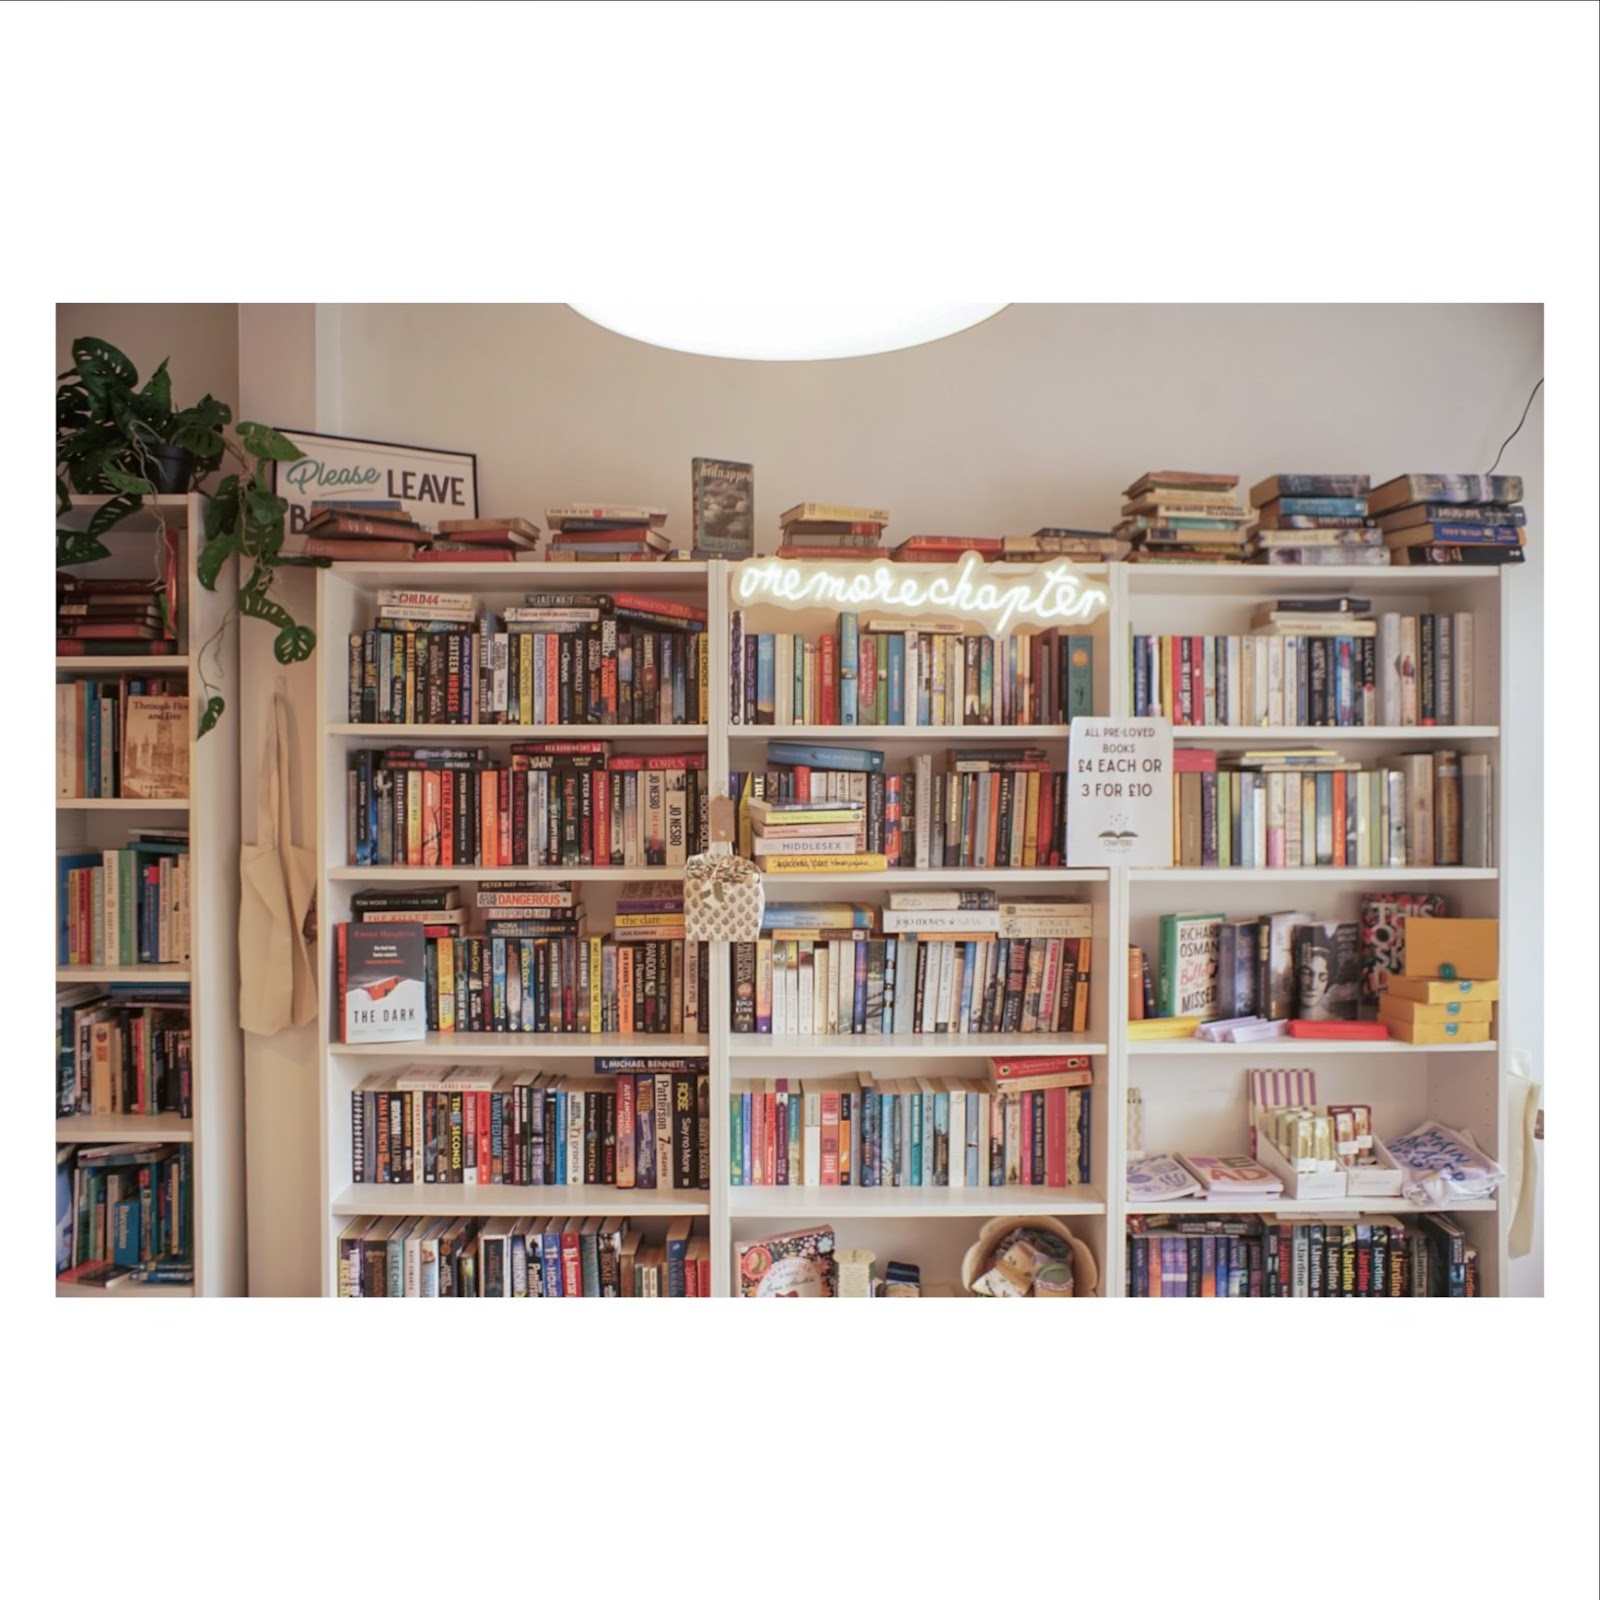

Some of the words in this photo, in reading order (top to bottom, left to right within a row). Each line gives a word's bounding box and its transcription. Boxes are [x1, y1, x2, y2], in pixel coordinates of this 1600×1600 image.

[285, 460, 381, 494] Please
[387, 469, 466, 506] LEAVE
[399, 593, 426, 605] CHILD
[426, 594, 440, 605] 44
[739, 562, 804, 600] one
[806, 566, 926, 607] more
[927, 556, 1107, 634] chapter
[447, 635, 460, 674] SIXTEEN
[523, 637, 531, 657] Ann
[536, 637, 544, 657] Ann
[549, 637, 557, 657] Ann
[523, 658, 531, 698] Cleeves
[536, 658, 544, 699] Cleeves
[549, 658, 557, 698] Cleeves
[560, 652, 571, 684] Cleeves
[447, 674, 460, 713] HORSES
[133, 701, 172, 712] Through
[173, 701, 189, 711] Flo
[1085, 728, 1100, 737] ALL
[1103, 728, 1156, 737] PRE-LOVED
[1102, 744, 1136, 753] BOOKS
[649, 757, 687, 770] CORPUS
[1077, 759, 1093, 773] £4
[1097, 759, 1137, 773] EACH
[1142, 759, 1162, 773] OR
[442, 772, 452, 805] PETER
[582, 773, 590, 797] PETER
[613, 774, 621, 796] PETER
[649, 773, 660, 784] JO
[649, 785, 660, 810] NESBO
[1001, 778, 1009, 814] BETRAYAL
[1081, 783, 1090, 797] 3
[1095, 783, 1123, 797] FOR
[1128, 783, 1153, 797] £10
[564, 796, 576, 821] Island
[582, 799, 590, 816] MAY
[613, 797, 621, 810] MAY
[669, 804, 682, 817] JO
[699, 794, 708, 823] BOOK
[442, 807, 452, 840] JAMES
[669, 818, 682, 847] NESBO
[782, 843, 842, 851] MIDDLESEX
[498, 894, 561, 905] DANGEROUS
[621, 914, 638, 925] the
[640, 912, 661, 925] dare
[915, 918, 945, 926] moyes
[1038, 919, 1070, 927] ROGUE
[1036, 927, 1074, 935] HERRIES
[471, 940, 480, 956] Alex
[551, 942, 559, 962] JAMES
[580, 942, 588, 961] JAMES
[659, 943, 667, 969] WATCH
[1179, 941, 1219, 958] OSMAN
[471, 956, 480, 974] Gray
[482, 948, 492, 972] death
[645, 943, 657, 980] RANDOM
[482, 973, 492, 988] rite
[551, 963, 559, 988] OSWALD
[580, 962, 588, 988] OSWALD
[635, 963, 644, 994] Rankin
[659, 969, 667, 984] HIM
[1061, 962, 1075, 1008] Historian
[659, 985, 667, 998] DIE
[1181, 985, 1217, 1013] MISSED
[353, 1010, 376, 1024] THE
[383, 1008, 416, 1023] DARK
[608, 1060, 646, 1069] MICHAEL
[647, 1060, 685, 1068] BENNETT
[378, 1094, 388, 1116] TANA
[452, 1096, 461, 1114] TEN
[656, 1079, 670, 1130] Patterson
[677, 1081, 689, 1112] ROSE
[491, 1100, 502, 1136] WANTED
[681, 1117, 692, 1136] Say
[378, 1116, 388, 1153] FRENCH
[681, 1137, 692, 1148] no
[452, 1125, 461, 1170] SECONDS
[491, 1136, 502, 1157] MAN
[570, 1140, 582, 1174] genesis
[1424, 1130, 1472, 1166] MAIN
[658, 1151, 671, 1178] HEAVEN
[681, 1148, 692, 1174] More
[390, 1254, 400, 1271] LEE
[390, 1272, 400, 1298] CHIL
